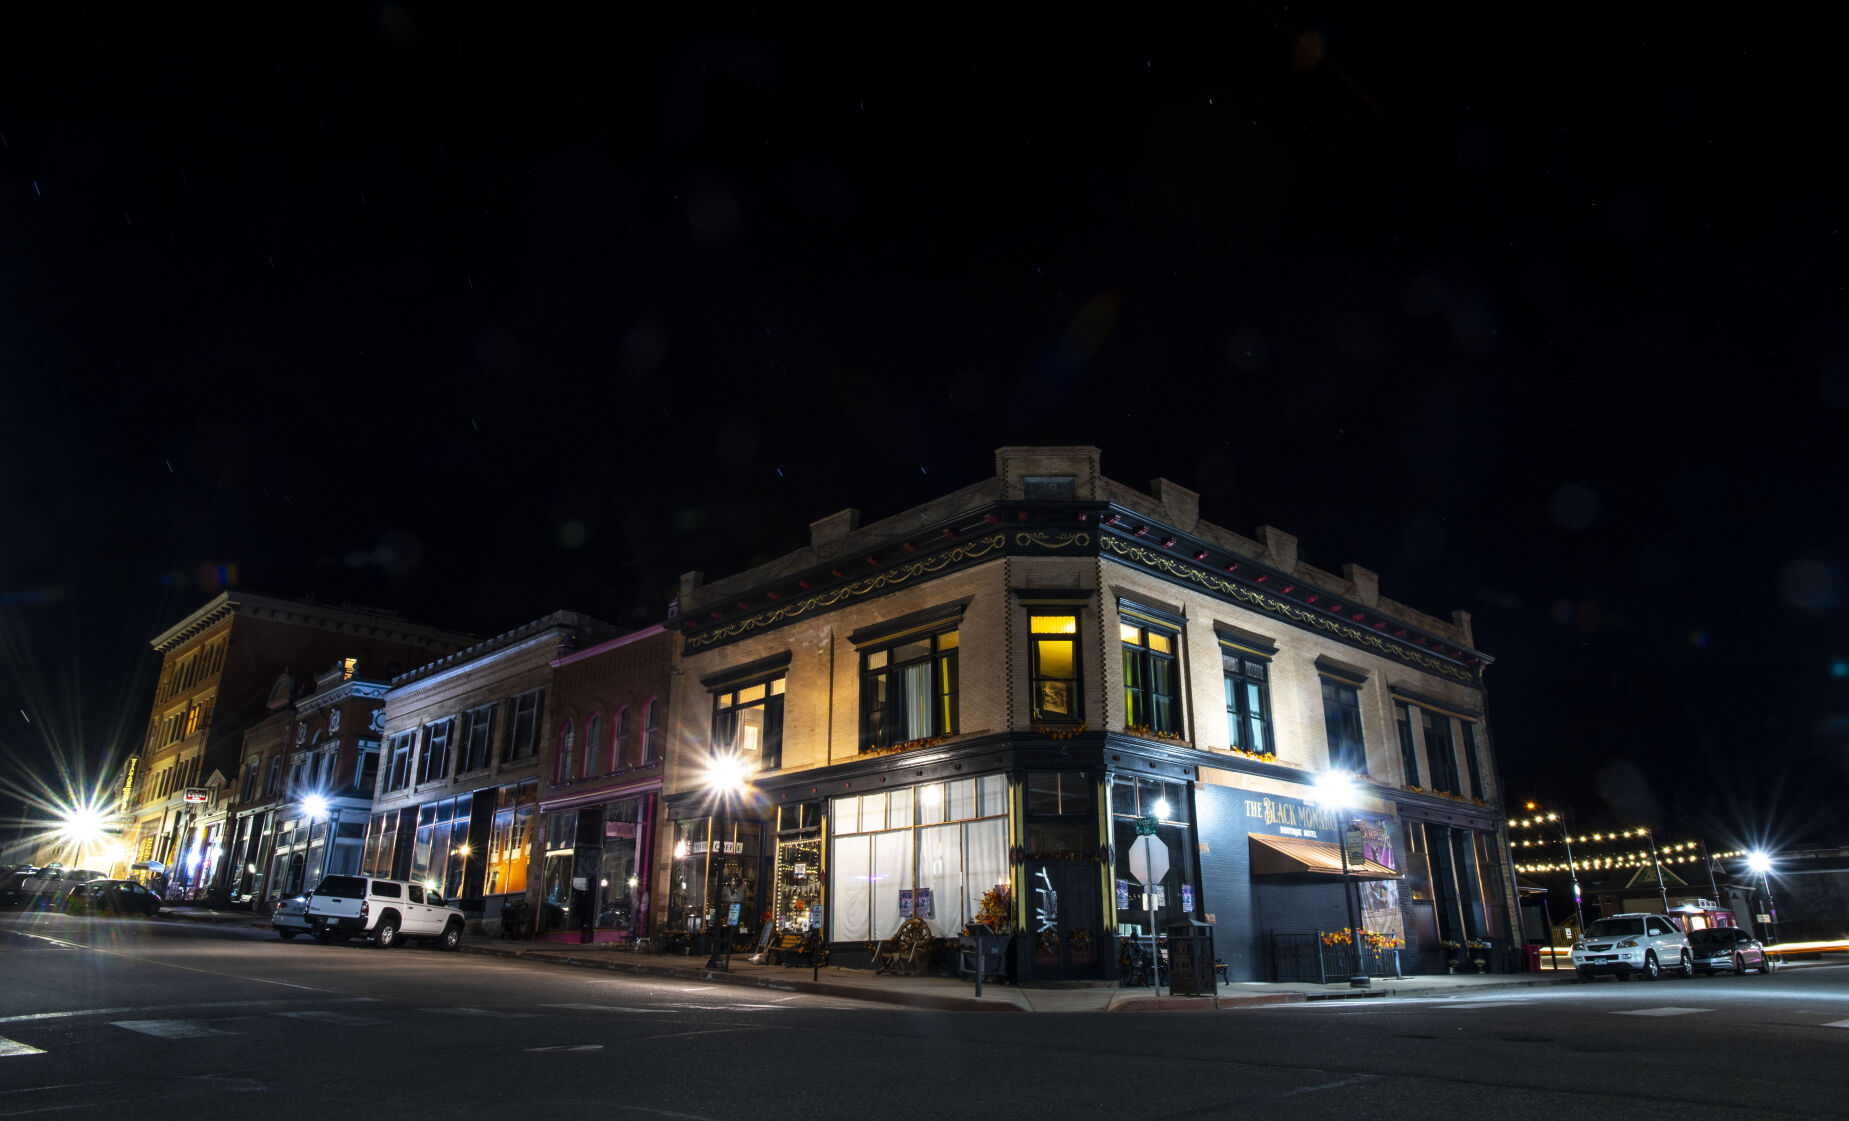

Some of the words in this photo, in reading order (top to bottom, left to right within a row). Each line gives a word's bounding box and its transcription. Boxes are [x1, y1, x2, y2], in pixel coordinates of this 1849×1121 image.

[1245, 800, 1263, 818] THE
[1263, 797, 1297, 826] BLACK
[1297, 805, 1339, 832] MONARC
